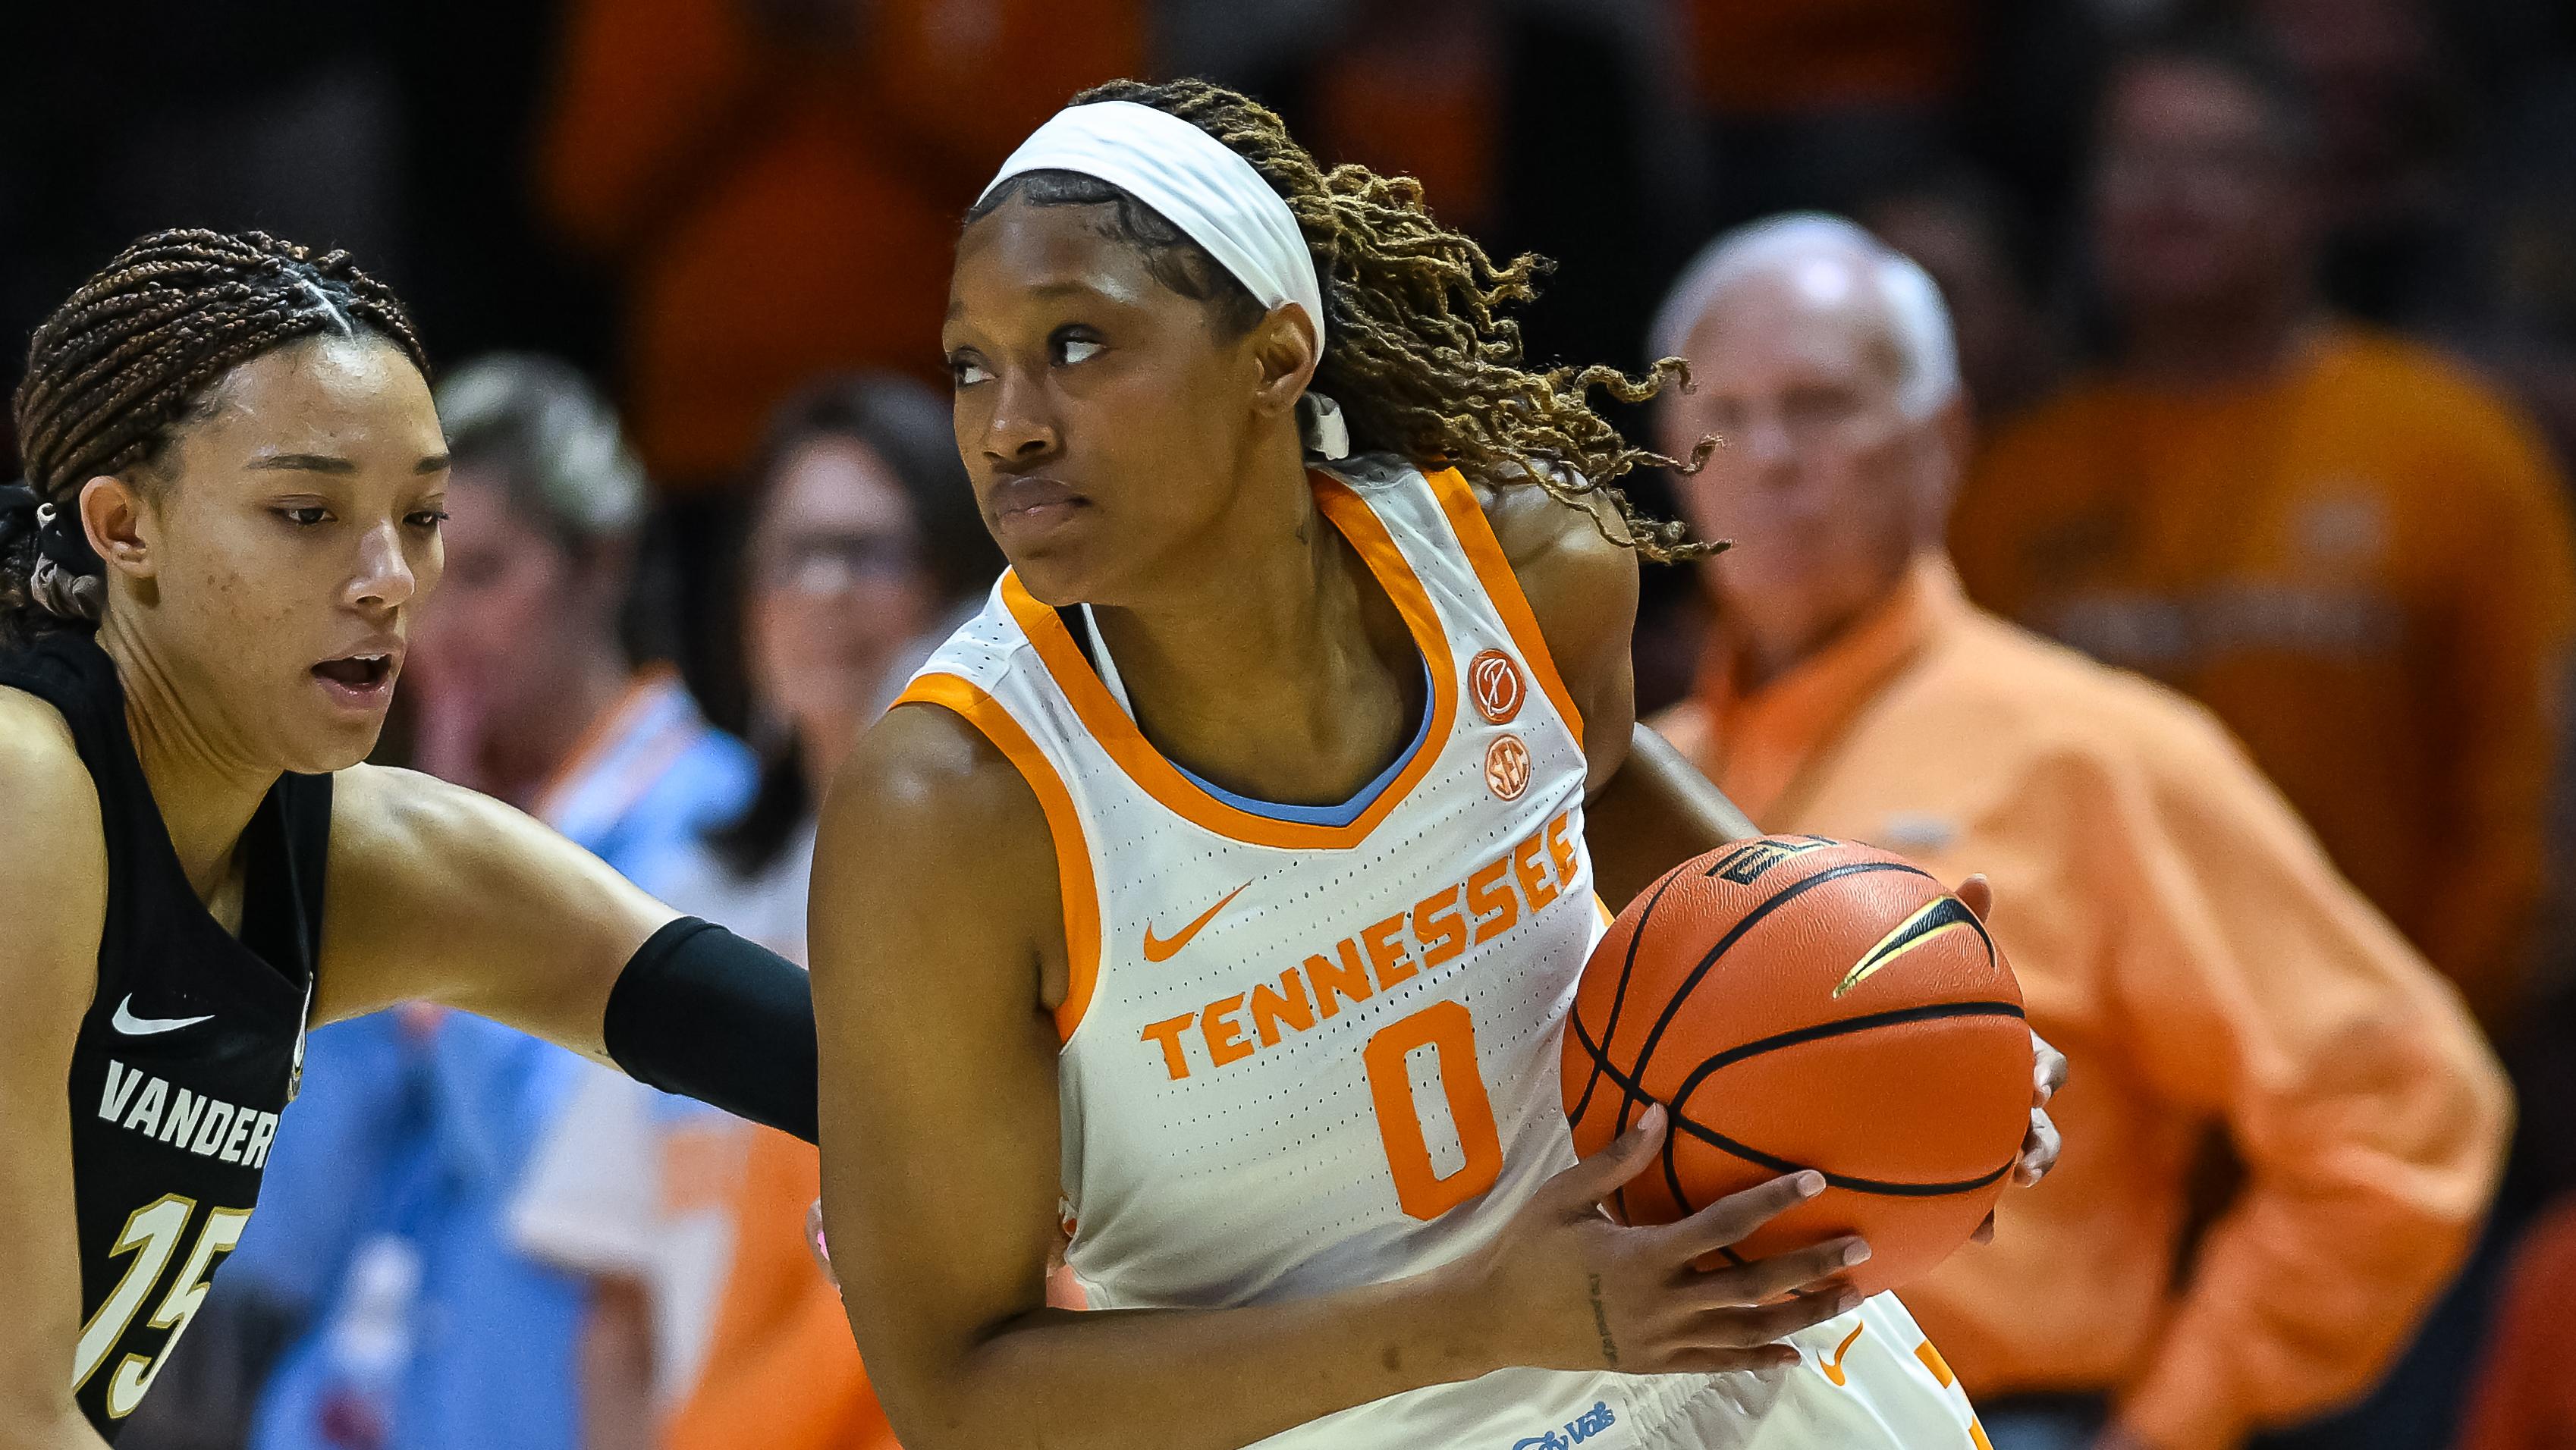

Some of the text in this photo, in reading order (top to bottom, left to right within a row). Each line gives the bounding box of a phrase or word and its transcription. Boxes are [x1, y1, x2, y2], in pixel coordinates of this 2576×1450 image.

[1488, 739, 1529, 797] SEC
[1140, 810, 1579, 1080] TENNESSEE
[98, 1059, 278, 1169] VANDER
[1362, 999, 1503, 1222] 0
[74, 1193, 256, 1419] 15
